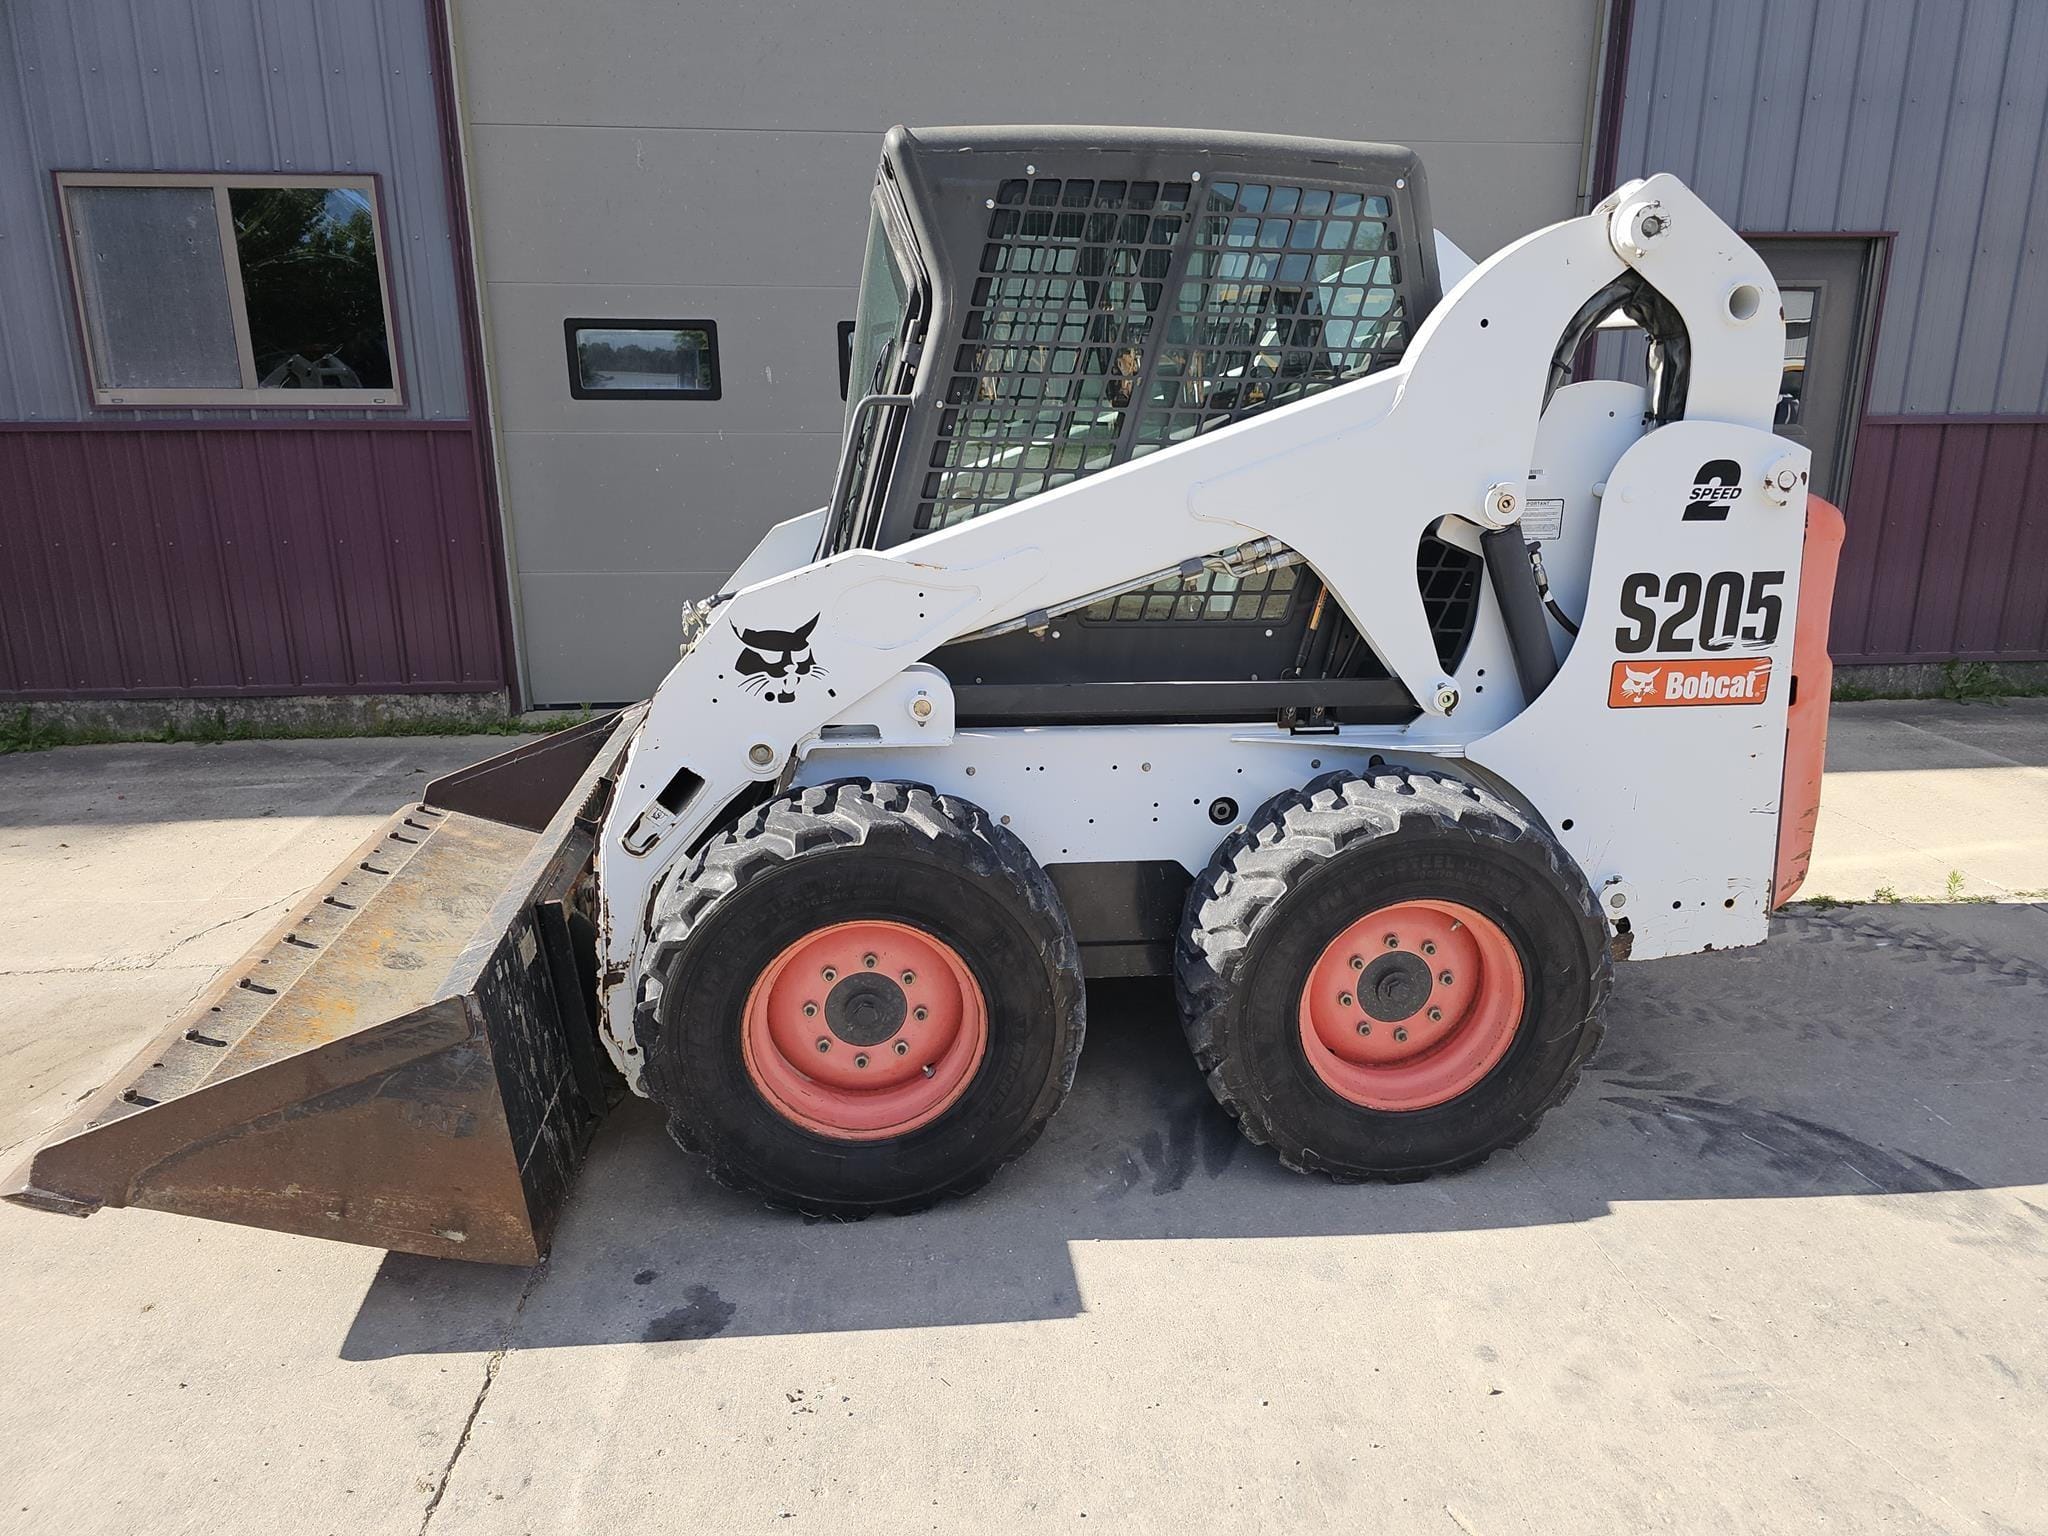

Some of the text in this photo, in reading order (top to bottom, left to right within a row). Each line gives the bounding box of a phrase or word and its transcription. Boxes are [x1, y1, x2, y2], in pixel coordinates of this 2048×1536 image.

[1681, 459, 1741, 521] 2
[1689, 487, 1743, 500] SPEED
[1615, 571, 1785, 653] S205
[1665, 671, 1757, 699] Bobcat
